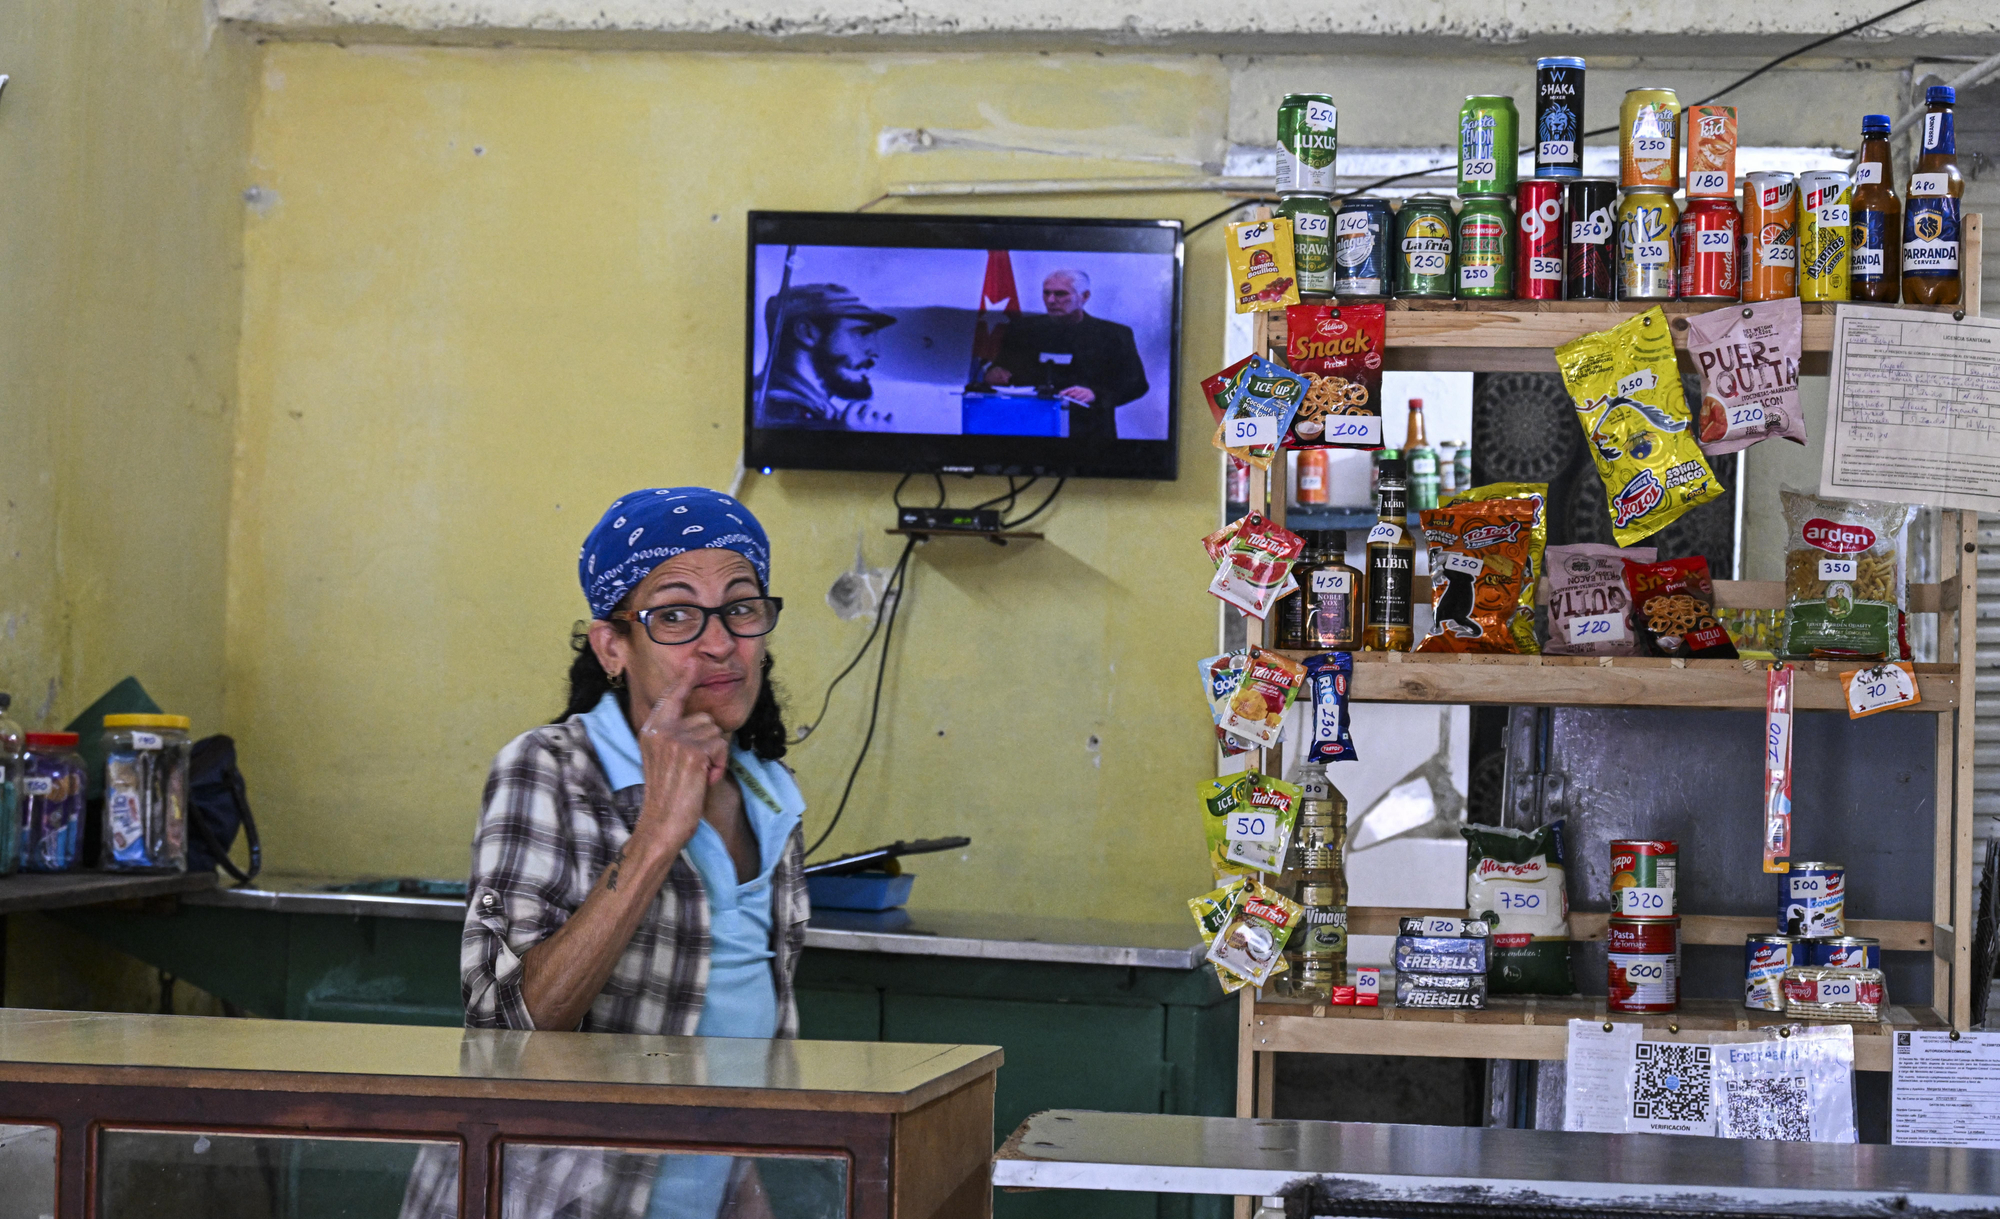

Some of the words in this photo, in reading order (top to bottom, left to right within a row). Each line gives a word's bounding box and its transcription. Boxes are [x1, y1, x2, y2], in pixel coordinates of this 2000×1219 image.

[1541, 84, 1575, 96] SHAKA
[1310, 108, 1333, 122] 250
[1461, 115, 1496, 133] Santa
[1700, 120, 1726, 137] kid
[1294, 134, 1336, 150] LUXUS
[1462, 129, 1494, 145] LEMON
[1542, 144, 1568, 156] 500
[1638, 140, 1665, 150] 250
[1466, 162, 1493, 176] 250
[1696, 174, 1724, 188] 180
[1916, 180, 1935, 190] 280
[1765, 192, 1776, 202] GO
[1521, 198, 1560, 241] go
[1822, 209, 1848, 221] 250
[1300, 218, 1326, 230] 250
[1340, 218, 1368, 231] 240
[1244, 229, 1262, 240] 50
[1573, 224, 1602, 239] 350
[1406, 240, 1422, 250] La
[1462, 239, 1498, 252] BEER
[1702, 233, 1730, 245] 250
[1639, 246, 1662, 257] 250
[1769, 248, 1795, 260] 250
[1806, 236, 1846, 280] Ananas
[1904, 246, 1956, 262] PARRANDA
[1250, 262, 1274, 272] Tomato
[1414, 256, 1444, 268] 250
[1534, 259, 1561, 273] 350
[1247, 266, 1278, 279] Bouillon
[1464, 270, 1488, 279] 250
[1294, 329, 1372, 360] Snack
[1698, 341, 1780, 378] PUER-
[1254, 382, 1273, 393] ICE
[1621, 378, 1643, 393] 250
[1245, 397, 1272, 412] Coconut
[1732, 408, 1762, 425] 120
[1235, 422, 1258, 438] 50
[1333, 422, 1369, 436] 100
[1372, 526, 1394, 537] 500
[1806, 527, 1868, 545] arden
[1248, 533, 1269, 550] Tuti
[1452, 558, 1478, 569] 250
[1824, 563, 1850, 574] 350
[1316, 576, 1343, 588] 450
[1568, 576, 1596, 585] BACON
[1577, 621, 1610, 636] 120
[1695, 629, 1720, 641] TUZLU
[1252, 666, 1270, 680] Tuti
[1271, 672, 1292, 686] Tuti
[1867, 684, 1886, 698] 70
[1321, 708, 1335, 737] 130
[1769, 722, 1781, 763] 100
[1217, 795, 1233, 811] ICE
[1252, 792, 1269, 804] Tuti
[1270, 796, 1288, 808] Tuti
[1236, 818, 1265, 835] 50
[1794, 880, 1818, 890] 500
[1500, 892, 1540, 908] 750
[1628, 891, 1664, 908] 320
[1248, 901, 1266, 916] Tuti
[1429, 921, 1454, 932] 120
[1614, 930, 1634, 939] Pasta
[1403, 955, 1478, 970] FREEGELLS
[1630, 964, 1662, 978] 500
[1360, 975, 1376, 986] 50
[1823, 985, 1850, 995] 200
[1406, 993, 1480, 1006] FREEGELLS
[1650, 1124, 1691, 1132] VERIFICACIÓN
